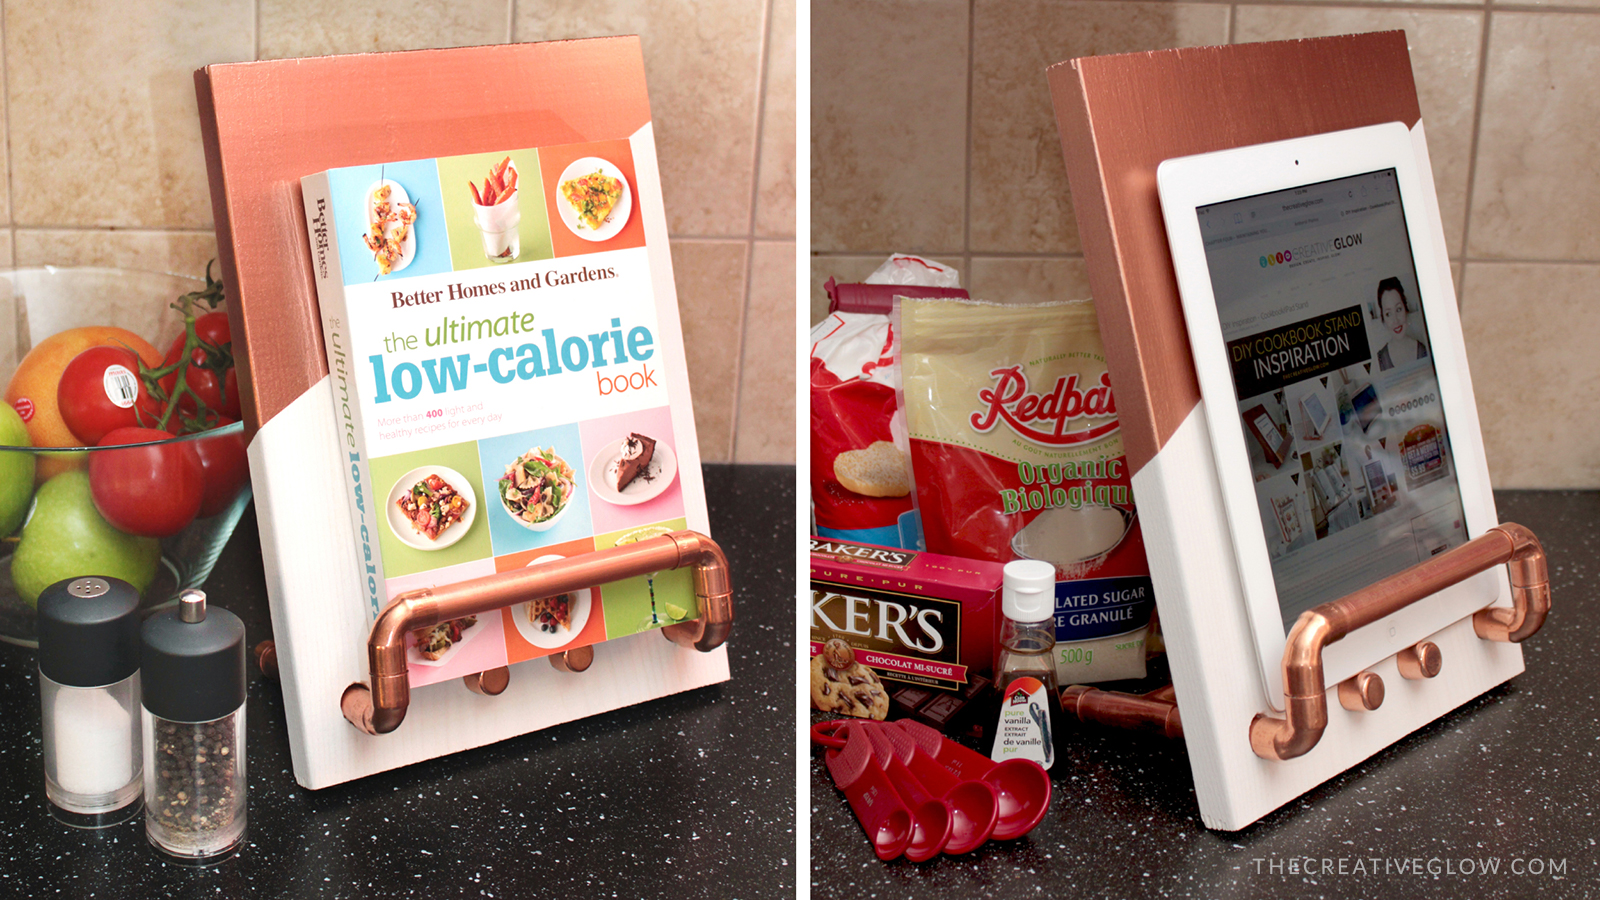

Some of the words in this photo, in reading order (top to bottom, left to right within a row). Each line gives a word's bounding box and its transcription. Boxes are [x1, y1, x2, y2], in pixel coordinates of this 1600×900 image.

[317, 198, 329, 251] Better
[312, 218, 328, 279] Homes
[390, 288, 443, 309] Better
[447, 279, 506, 301] Homes
[510, 269, 542, 292] and
[329, 316, 341, 329] the
[383, 332, 418, 353] the
[425, 311, 535, 347] ultimate
[1232, 342, 1252, 362] DIY
[1255, 322, 1323, 355] COOKBOOK
[1324, 312, 1361, 335] STAND
[368, 317, 654, 404] low-calorie
[1029, 352, 1066, 367] NATURALLY
[1094, 354, 1107, 364] TAS
[1253, 332, 1350, 379] INSPIRATION
[331, 332, 356, 448] ultimate
[597, 363, 658, 396] book
[377, 417, 401, 428] More
[403, 412, 424, 424] than
[426, 409, 443, 419] 400
[444, 405, 465, 417] light
[466, 401, 483, 412] and
[379, 427, 413, 441] healthy
[415, 423, 447, 435] recipes
[447, 419, 459, 429] for
[461, 415, 486, 427] every
[487, 412, 503, 423] day
[1012, 439, 1022, 447] AU
[1044, 445, 1102, 459] NATURELLEMENT
[1104, 438, 1119, 449] BON
[1018, 455, 1122, 485] Organic
[882, 579, 923, 590] PUR
[1102, 586, 1145, 604] SUGAR
[1069, 606, 1133, 627] GRANULÉ
[866, 655, 912, 669] CHOCOLAT
[914, 662, 953, 676] MI-SUCRÉ
[1060, 647, 1083, 665] 500
[1085, 649, 1093, 666] g
[1004, 710, 1024, 718] pure
[1004, 717, 1031, 725] vanilla
[1003, 746, 1018, 754] pur
[1015, 738, 1041, 746] vanille
